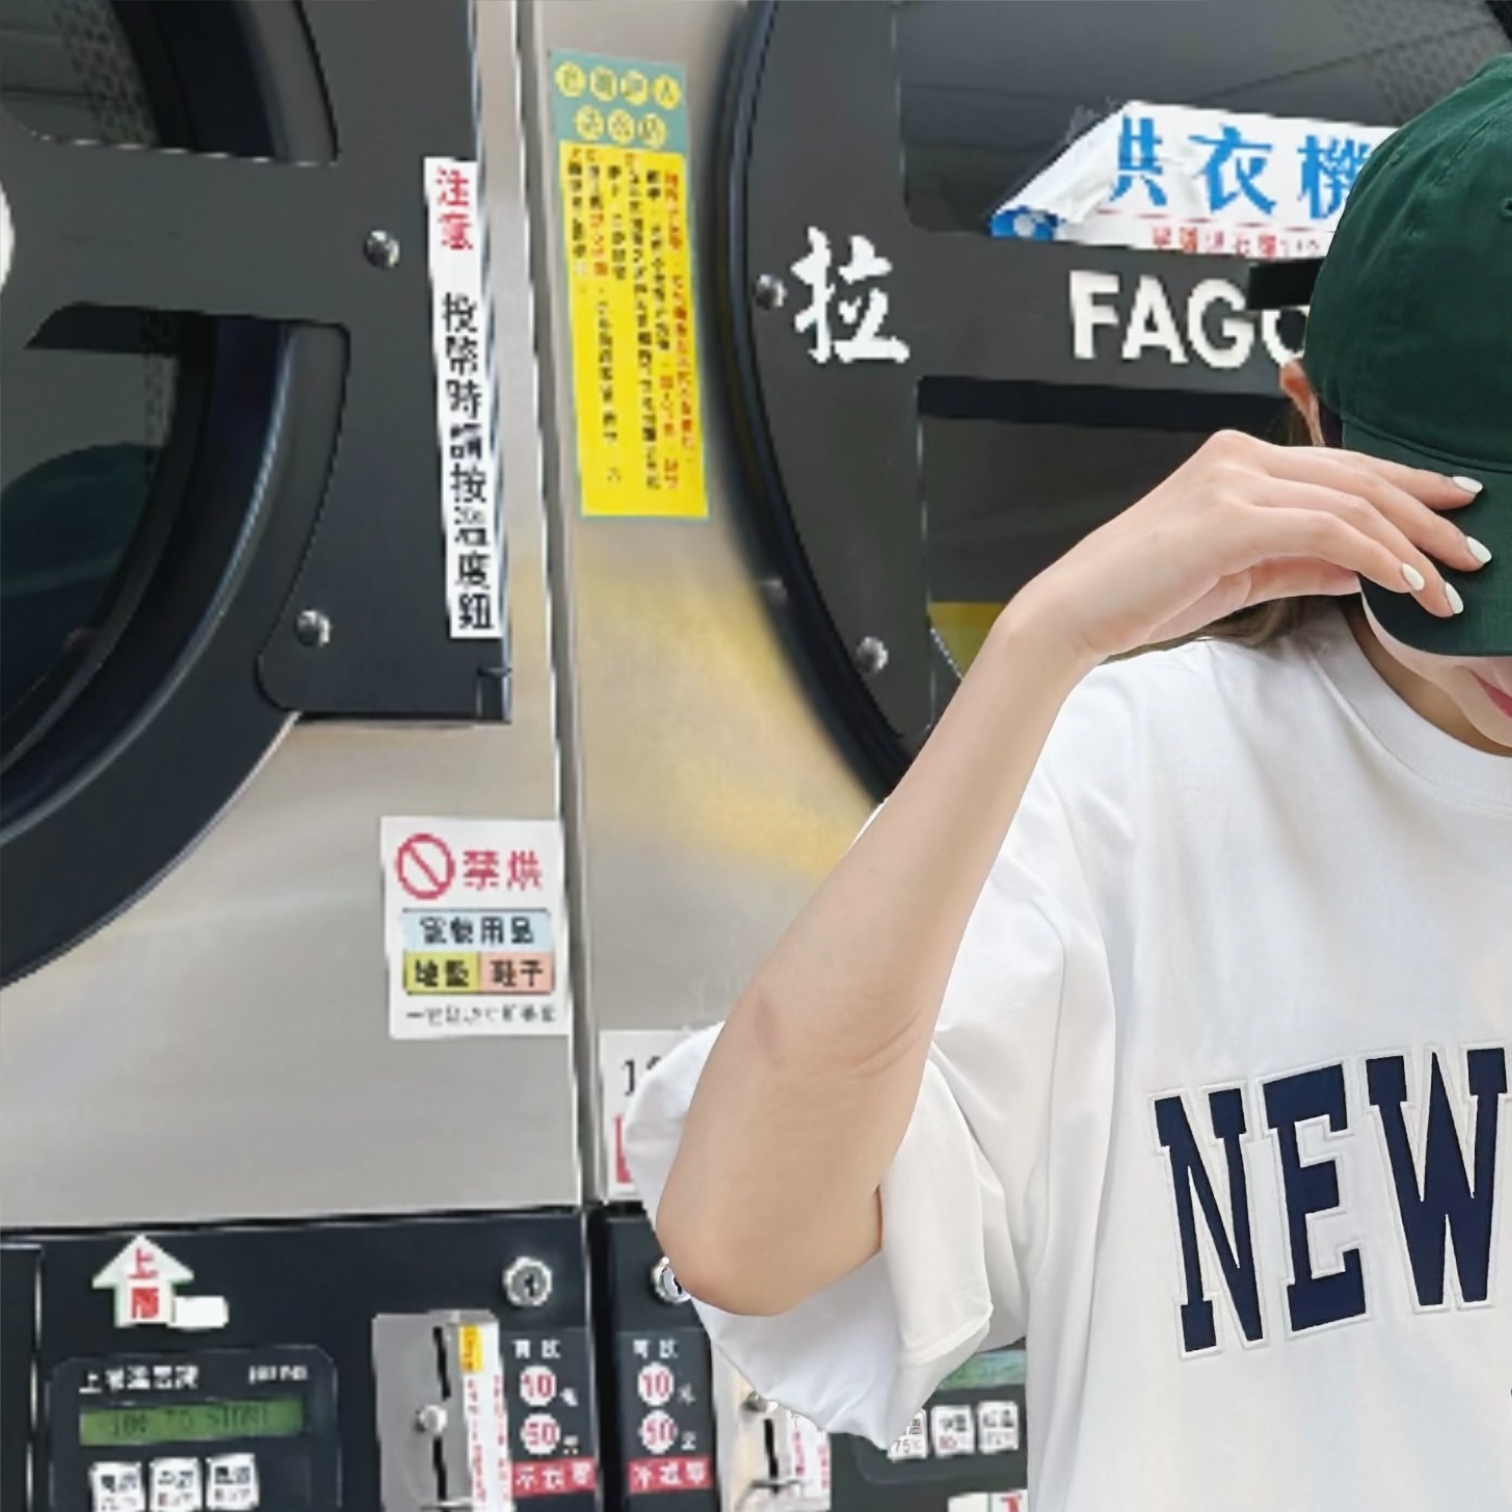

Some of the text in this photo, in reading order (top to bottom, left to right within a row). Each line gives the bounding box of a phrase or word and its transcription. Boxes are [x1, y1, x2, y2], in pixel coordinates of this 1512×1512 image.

[436, 166, 474, 250] 注意
[791, 226, 909, 364] 拉
[1152, 1044, 1511, 1355] NEW
